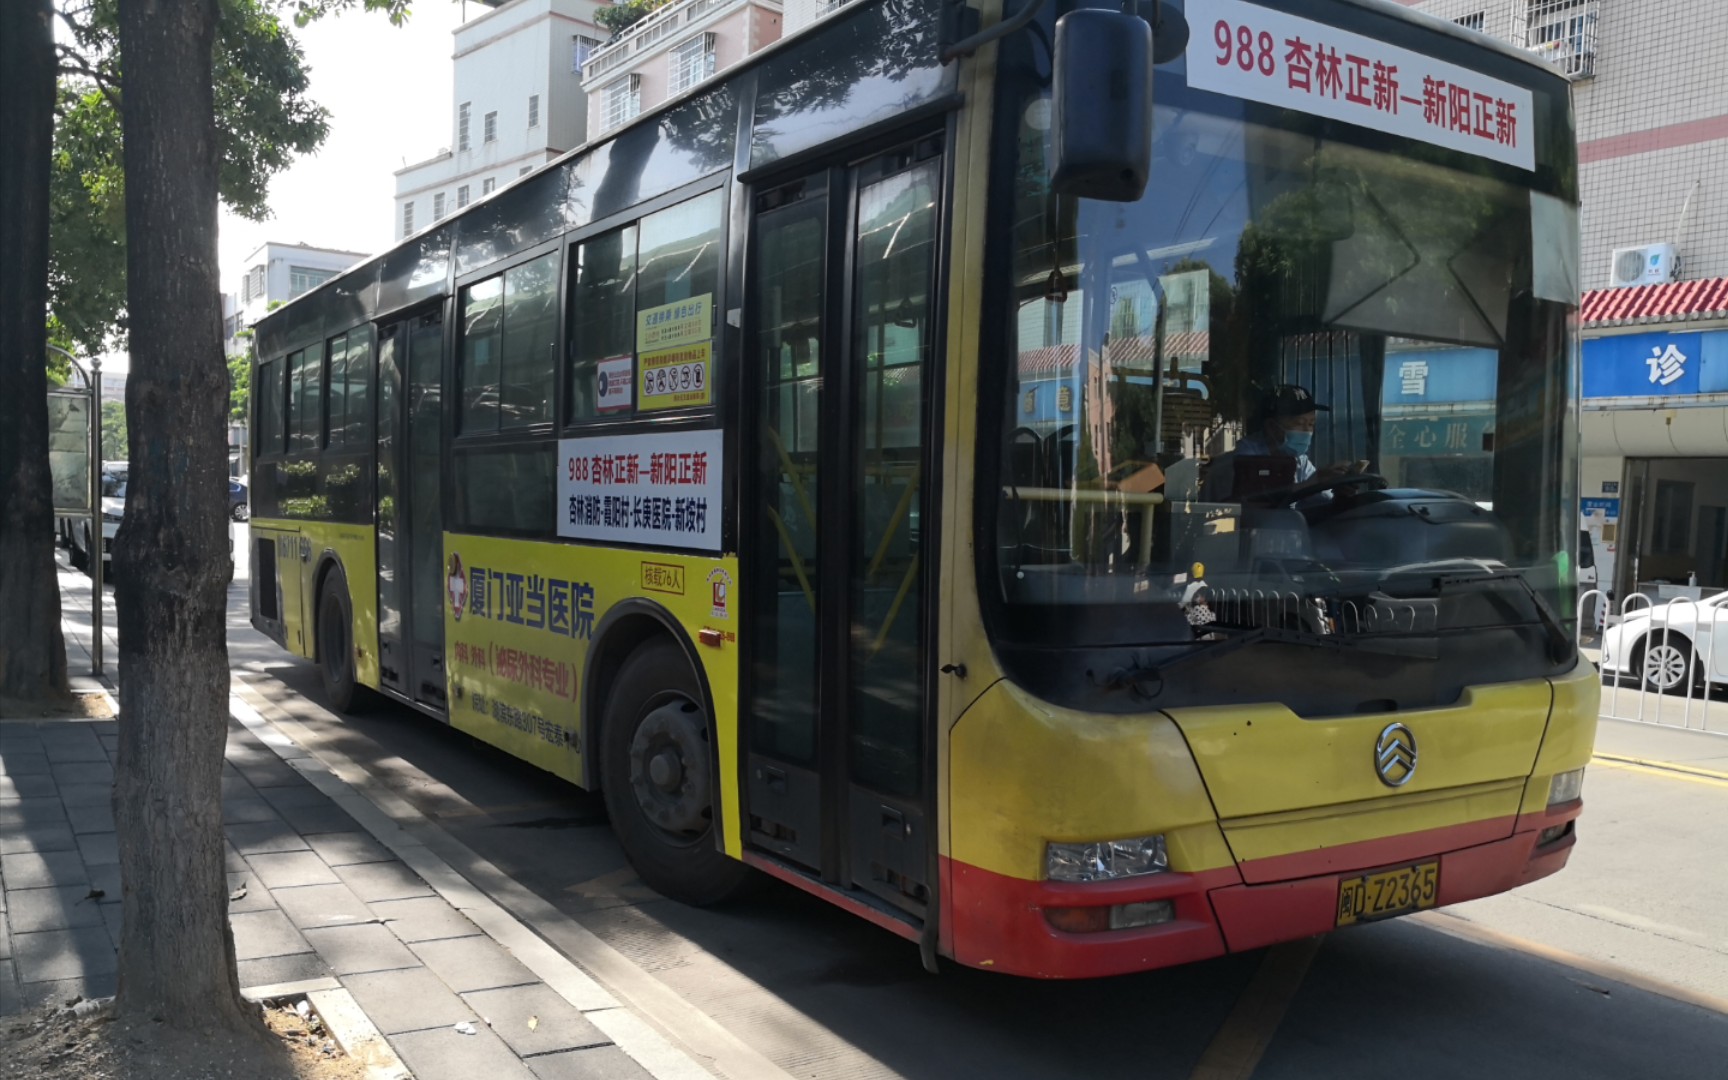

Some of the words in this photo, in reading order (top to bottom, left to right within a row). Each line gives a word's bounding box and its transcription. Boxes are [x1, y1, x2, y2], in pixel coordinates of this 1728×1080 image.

[1214, 20, 1275, 77] 988
[1399, 361, 1428, 395] 雪
[1646, 344, 1687, 386] 诊
[569, 457, 589, 481] 988
[645, 566, 680, 589] 核载76人
[469, 566, 595, 641] 厦门亚当医院
